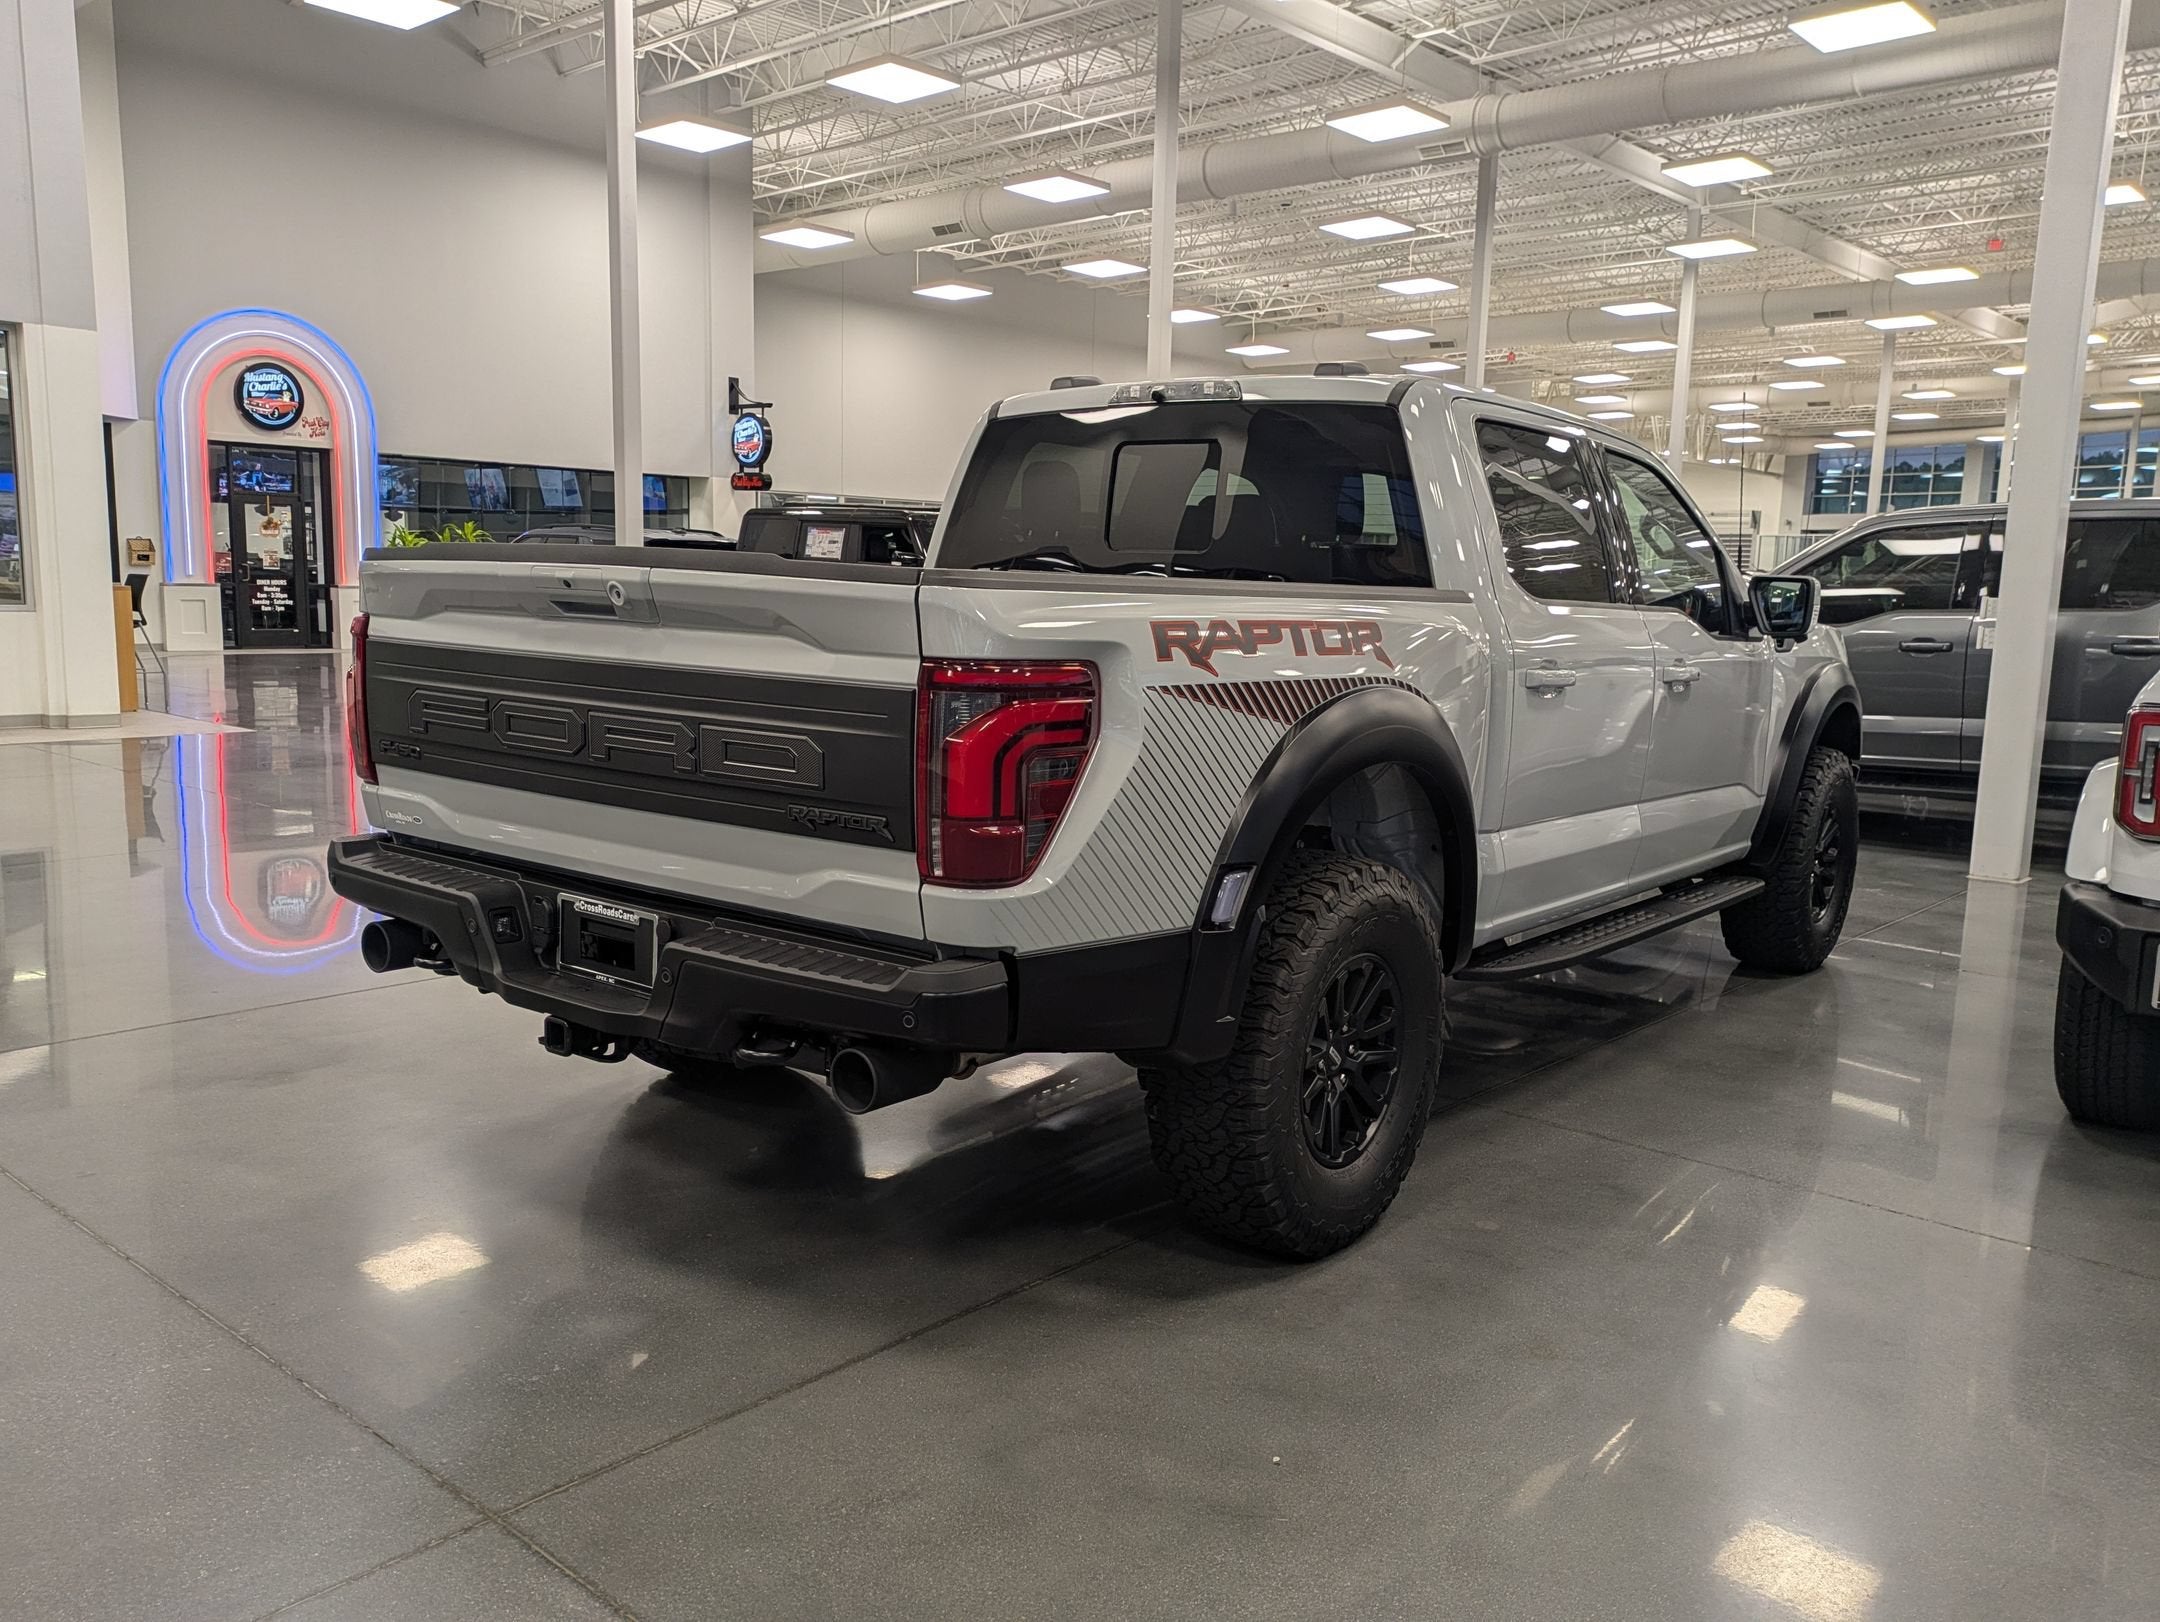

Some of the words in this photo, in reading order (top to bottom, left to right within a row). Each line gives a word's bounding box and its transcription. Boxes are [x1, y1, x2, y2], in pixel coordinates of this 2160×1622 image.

[243, 372, 284, 384] Mustang
[248, 381, 288, 392] Charlie's
[274, 598, 294, 606] Saturday
[1149, 619, 1396, 677] RAPTOR
[407, 688, 826, 791] FORD
[787, 802, 895, 842] RAPTOR
